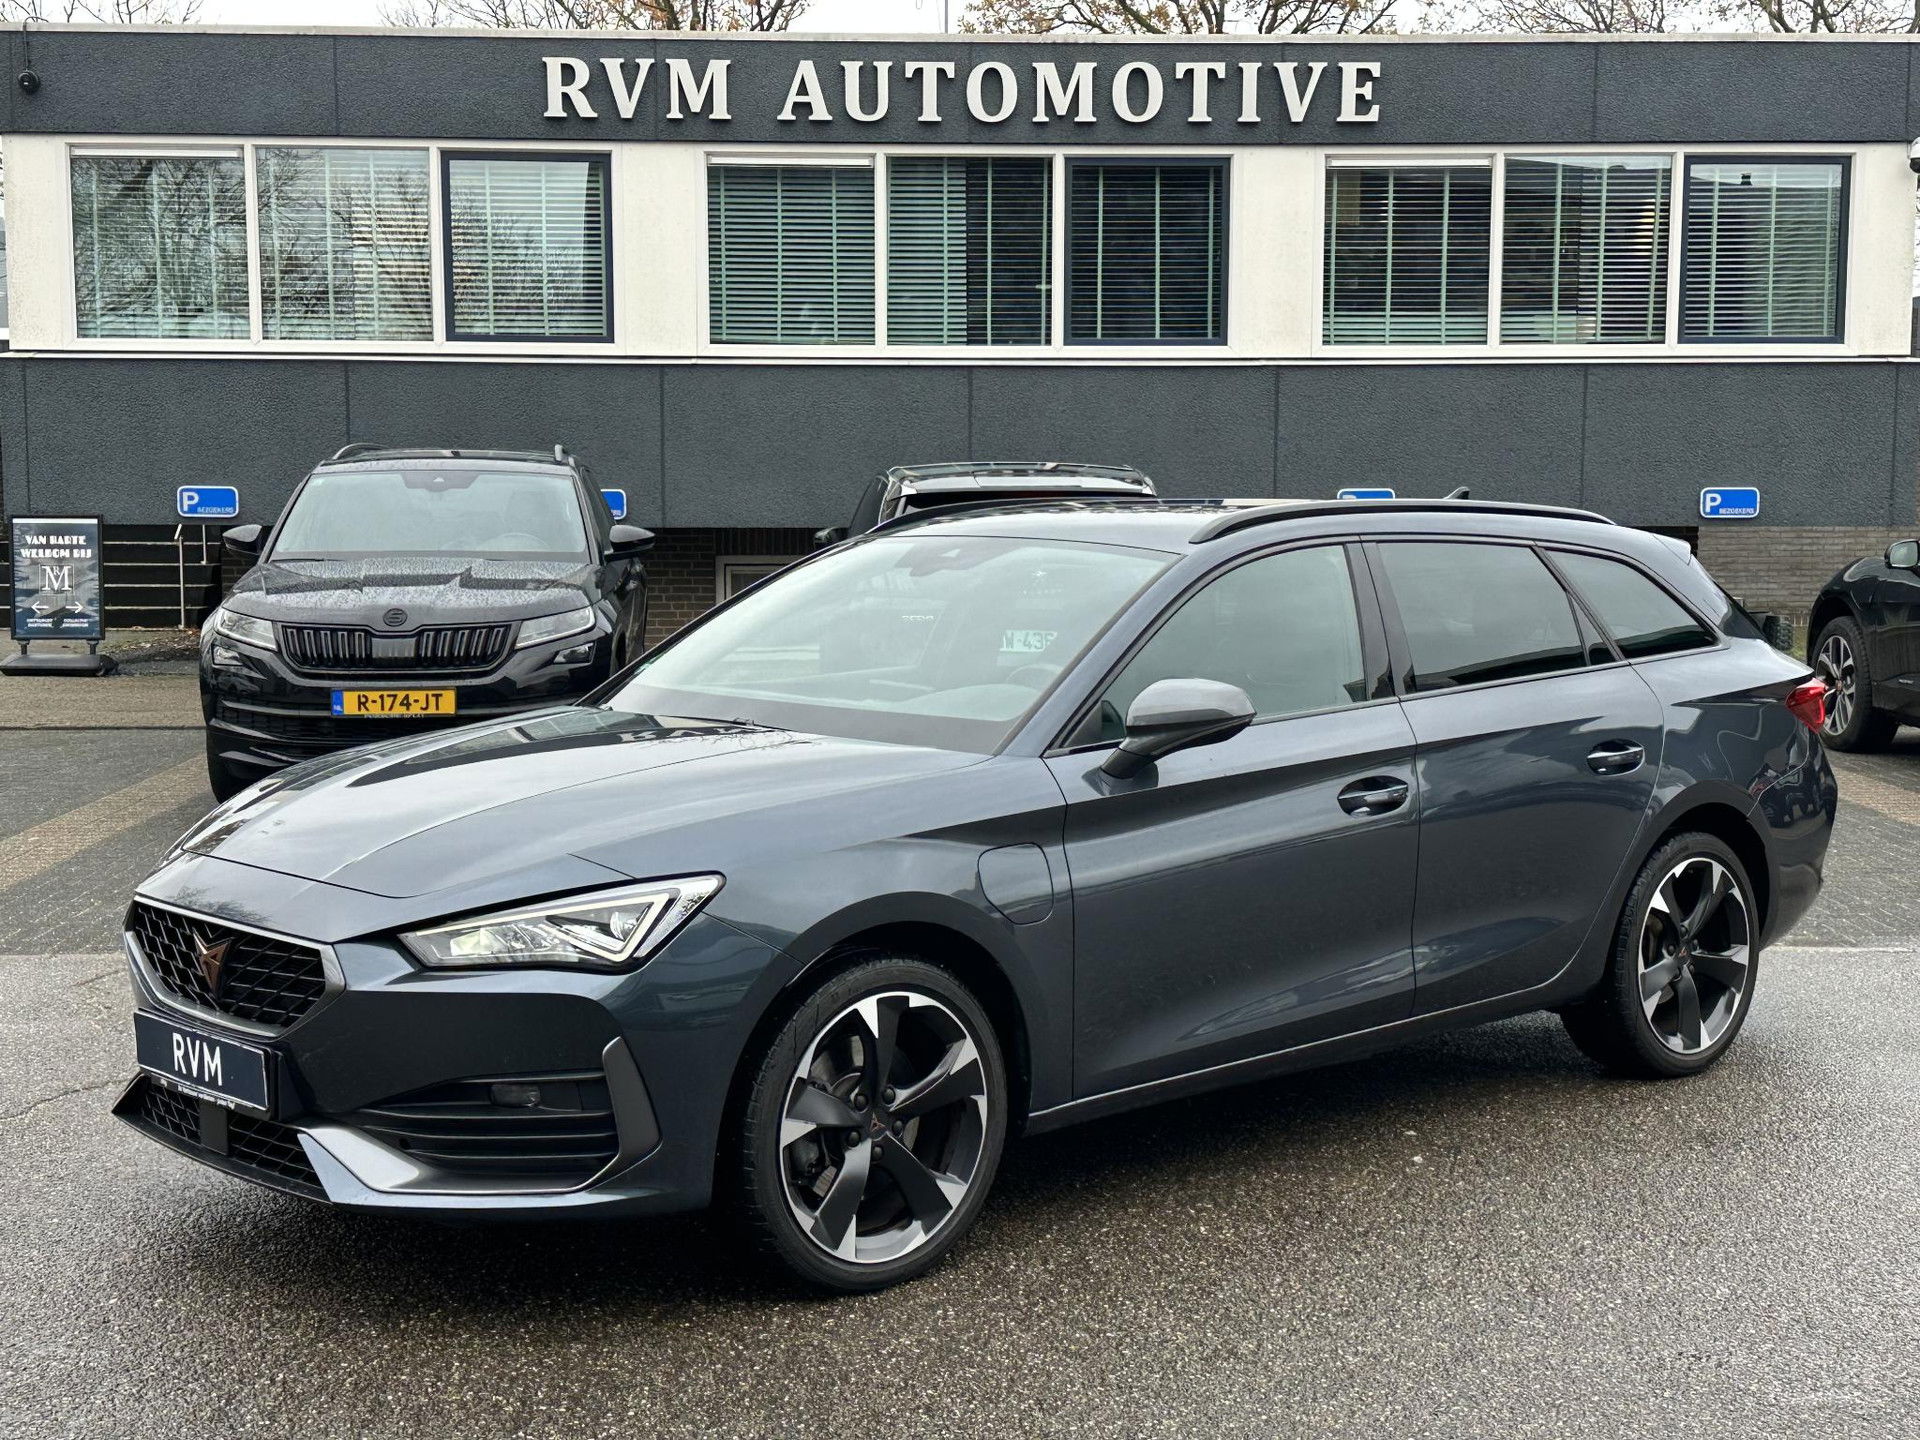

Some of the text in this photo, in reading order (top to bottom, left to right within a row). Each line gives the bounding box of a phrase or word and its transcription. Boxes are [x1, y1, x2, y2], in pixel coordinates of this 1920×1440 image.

[541, 56, 1382, 124] RVM AUTOMOTIVE
[182, 491, 200, 512] P
[1705, 493, 1722, 513] P
[25, 535, 47, 545] VAN
[357, 693, 443, 711] R-174-JT
[172, 1032, 223, 1086] RVM
